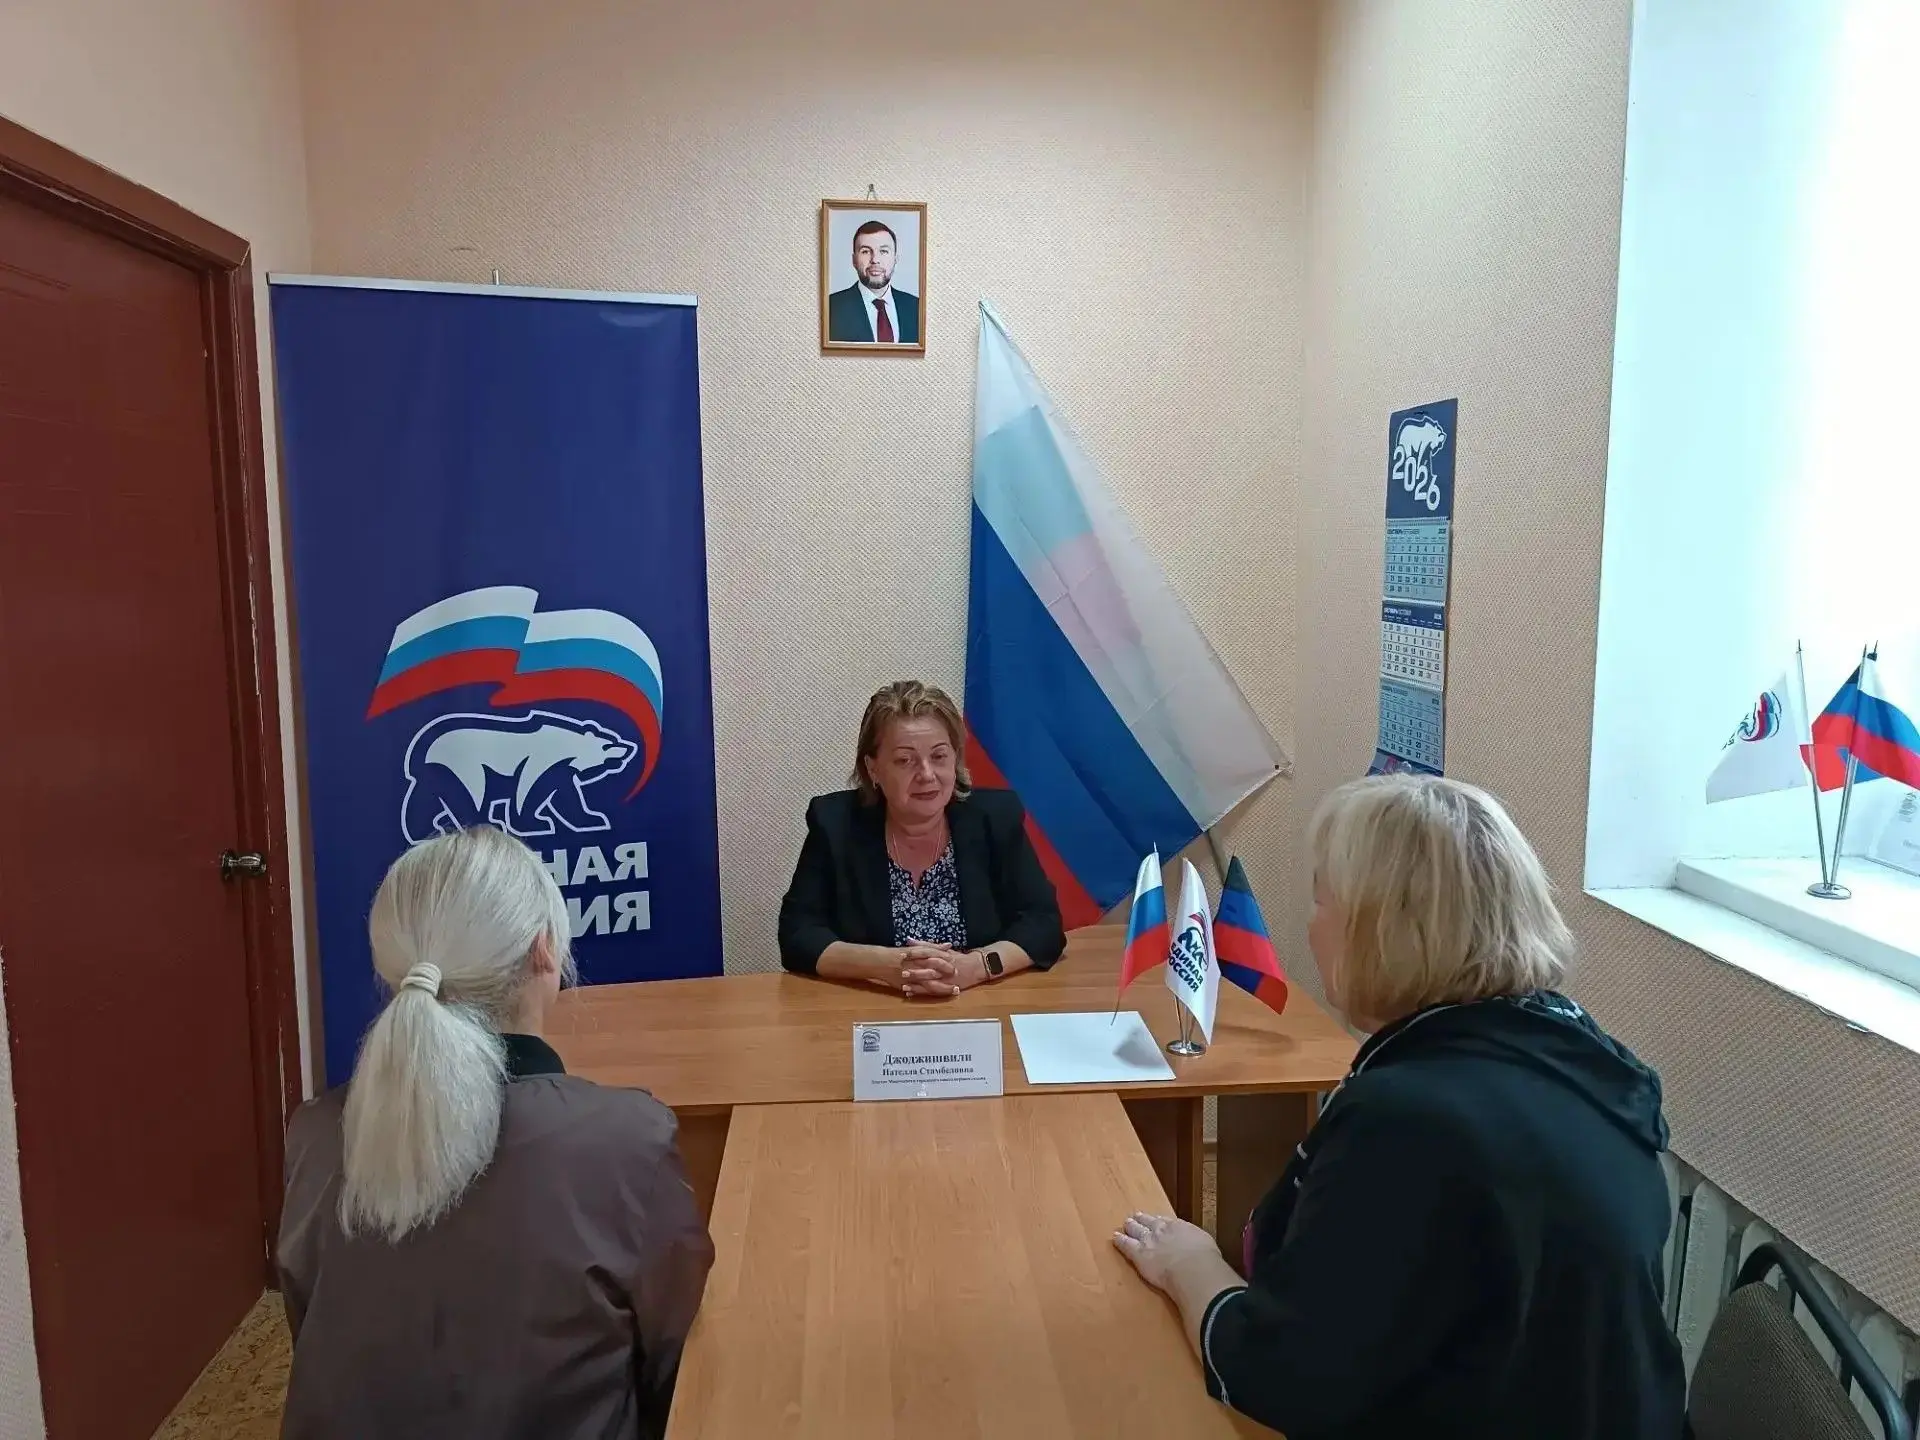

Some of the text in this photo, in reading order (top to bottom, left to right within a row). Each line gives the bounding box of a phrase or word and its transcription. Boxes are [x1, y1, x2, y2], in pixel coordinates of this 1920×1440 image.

[1392, 444, 1440, 510] 2026
[533, 842, 648, 886] НАЯ
[1170, 942, 1204, 984] ЕДИНАЯ
[882, 1053, 972, 1066] Джоджишвили
